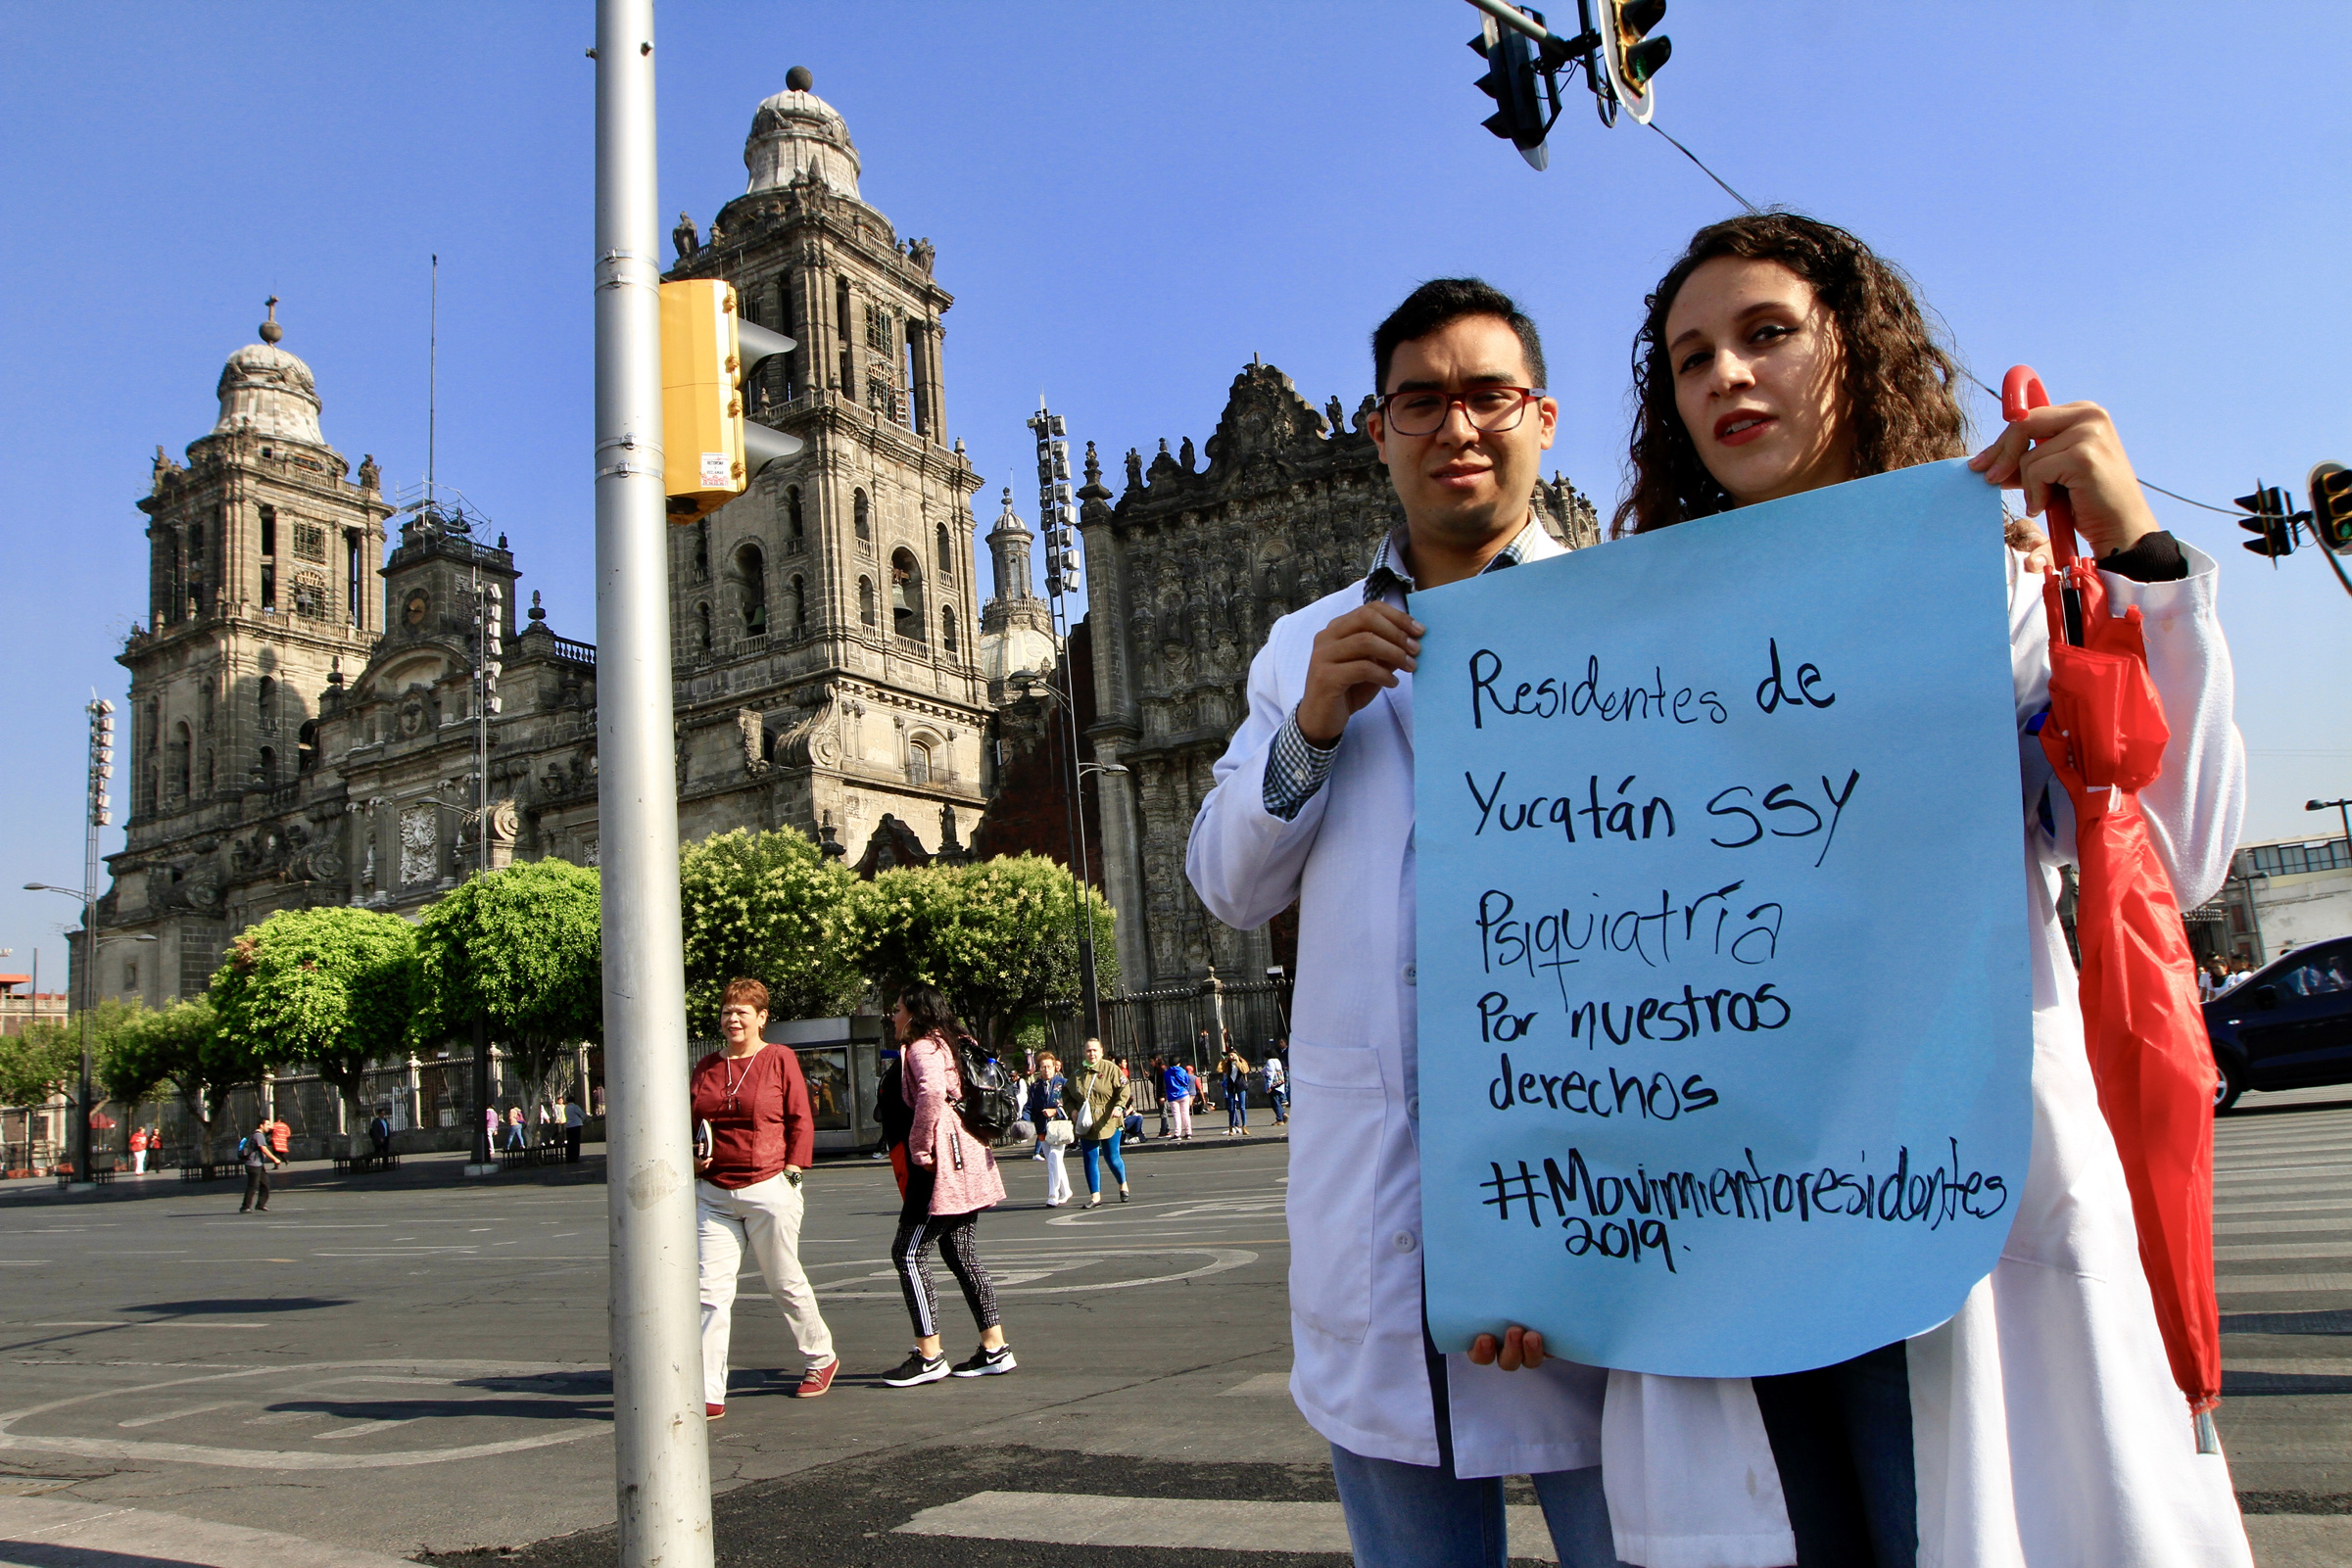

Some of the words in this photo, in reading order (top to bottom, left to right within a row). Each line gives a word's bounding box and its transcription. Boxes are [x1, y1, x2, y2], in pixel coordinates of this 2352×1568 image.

[1469, 649, 1727, 729] Residentes
[1756, 638, 1835, 715] de
[1465, 771, 1675, 842] Yucatán
[1477, 879, 1783, 1013] Psiquiatría
[1477, 991, 1534, 1043] Por
[1571, 983, 1791, 1050] nuestros
[1490, 1053, 1718, 1120] derechos
